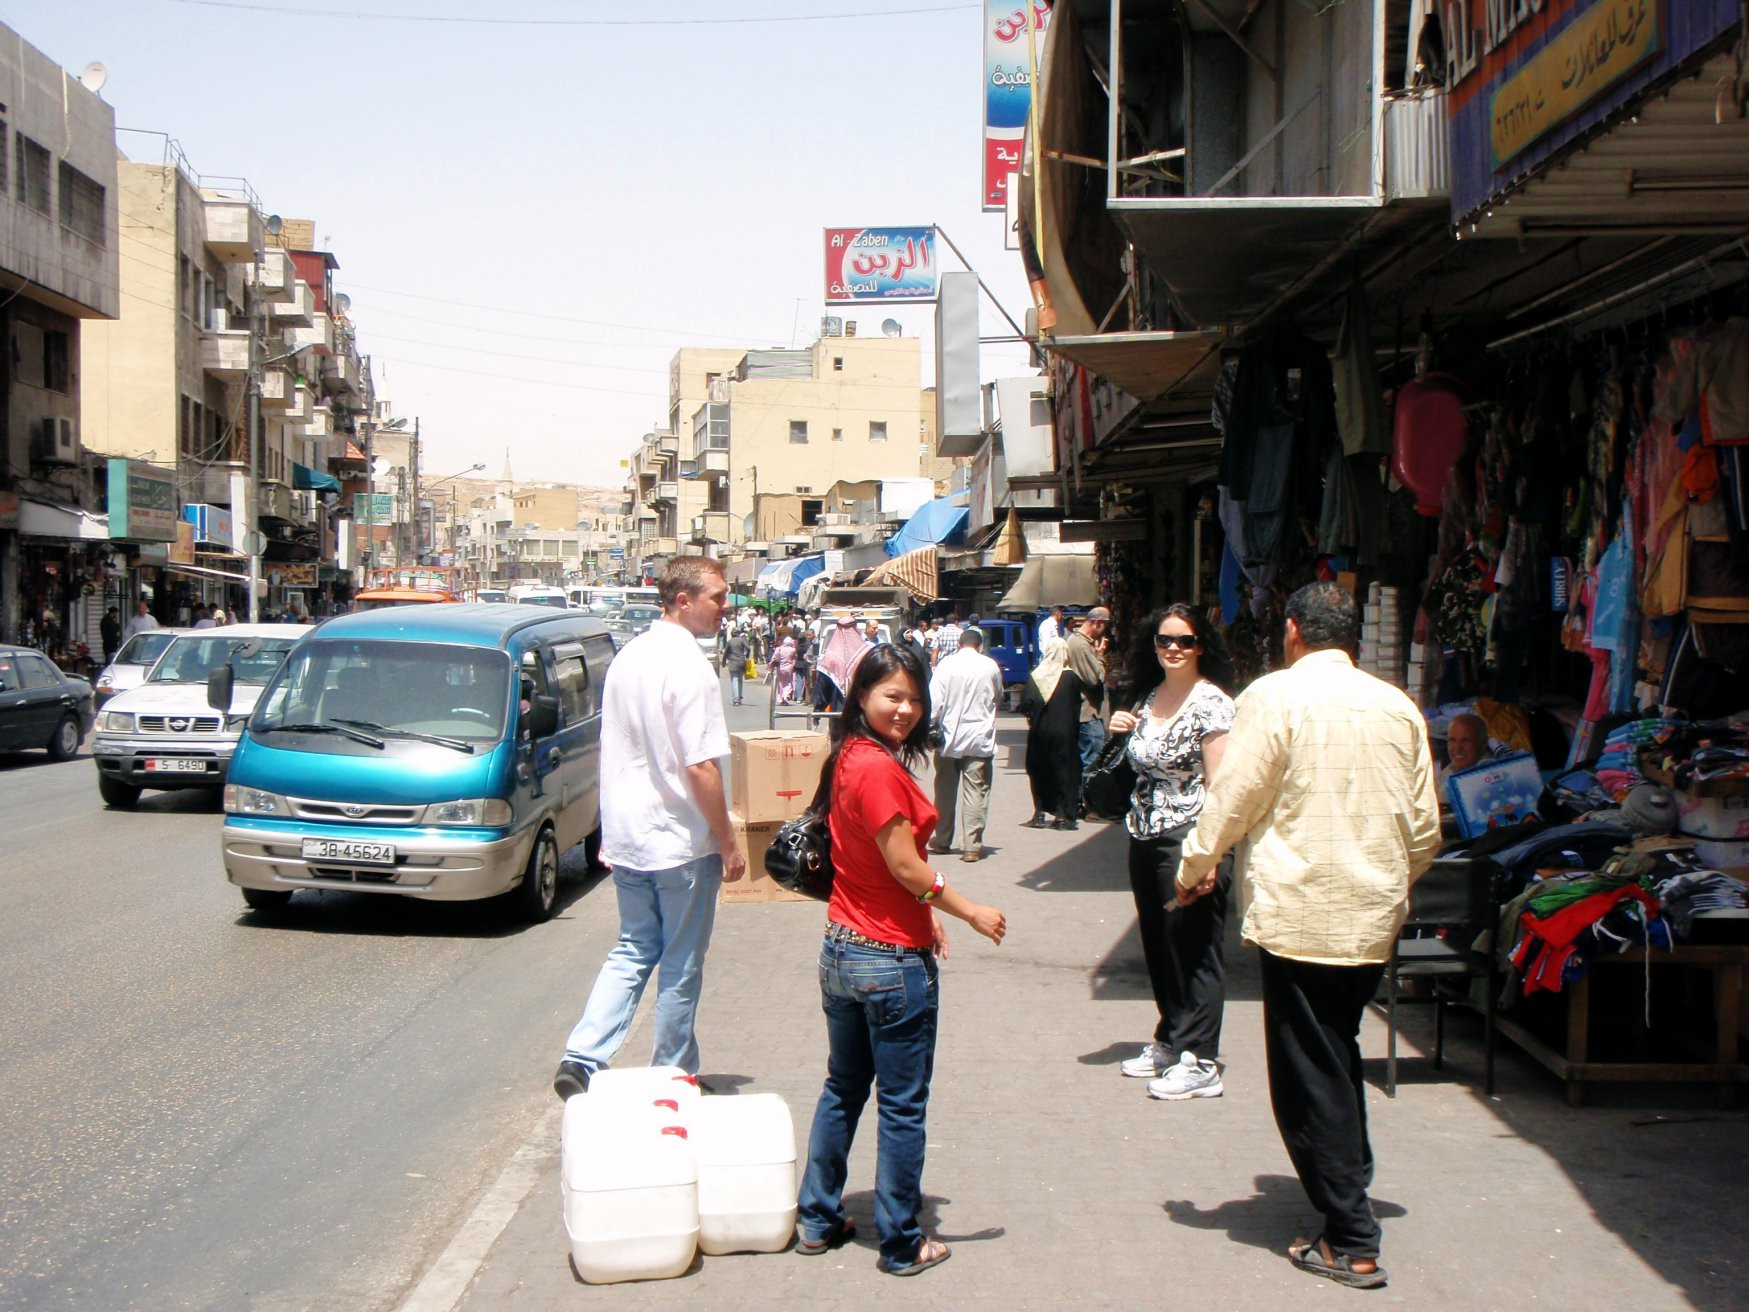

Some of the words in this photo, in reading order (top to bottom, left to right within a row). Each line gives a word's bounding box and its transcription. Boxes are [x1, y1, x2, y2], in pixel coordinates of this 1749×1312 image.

[831, 234, 844, 247] Al
[853, 233, 889, 247] Zaben
[851, 236, 930, 282] الزبن
